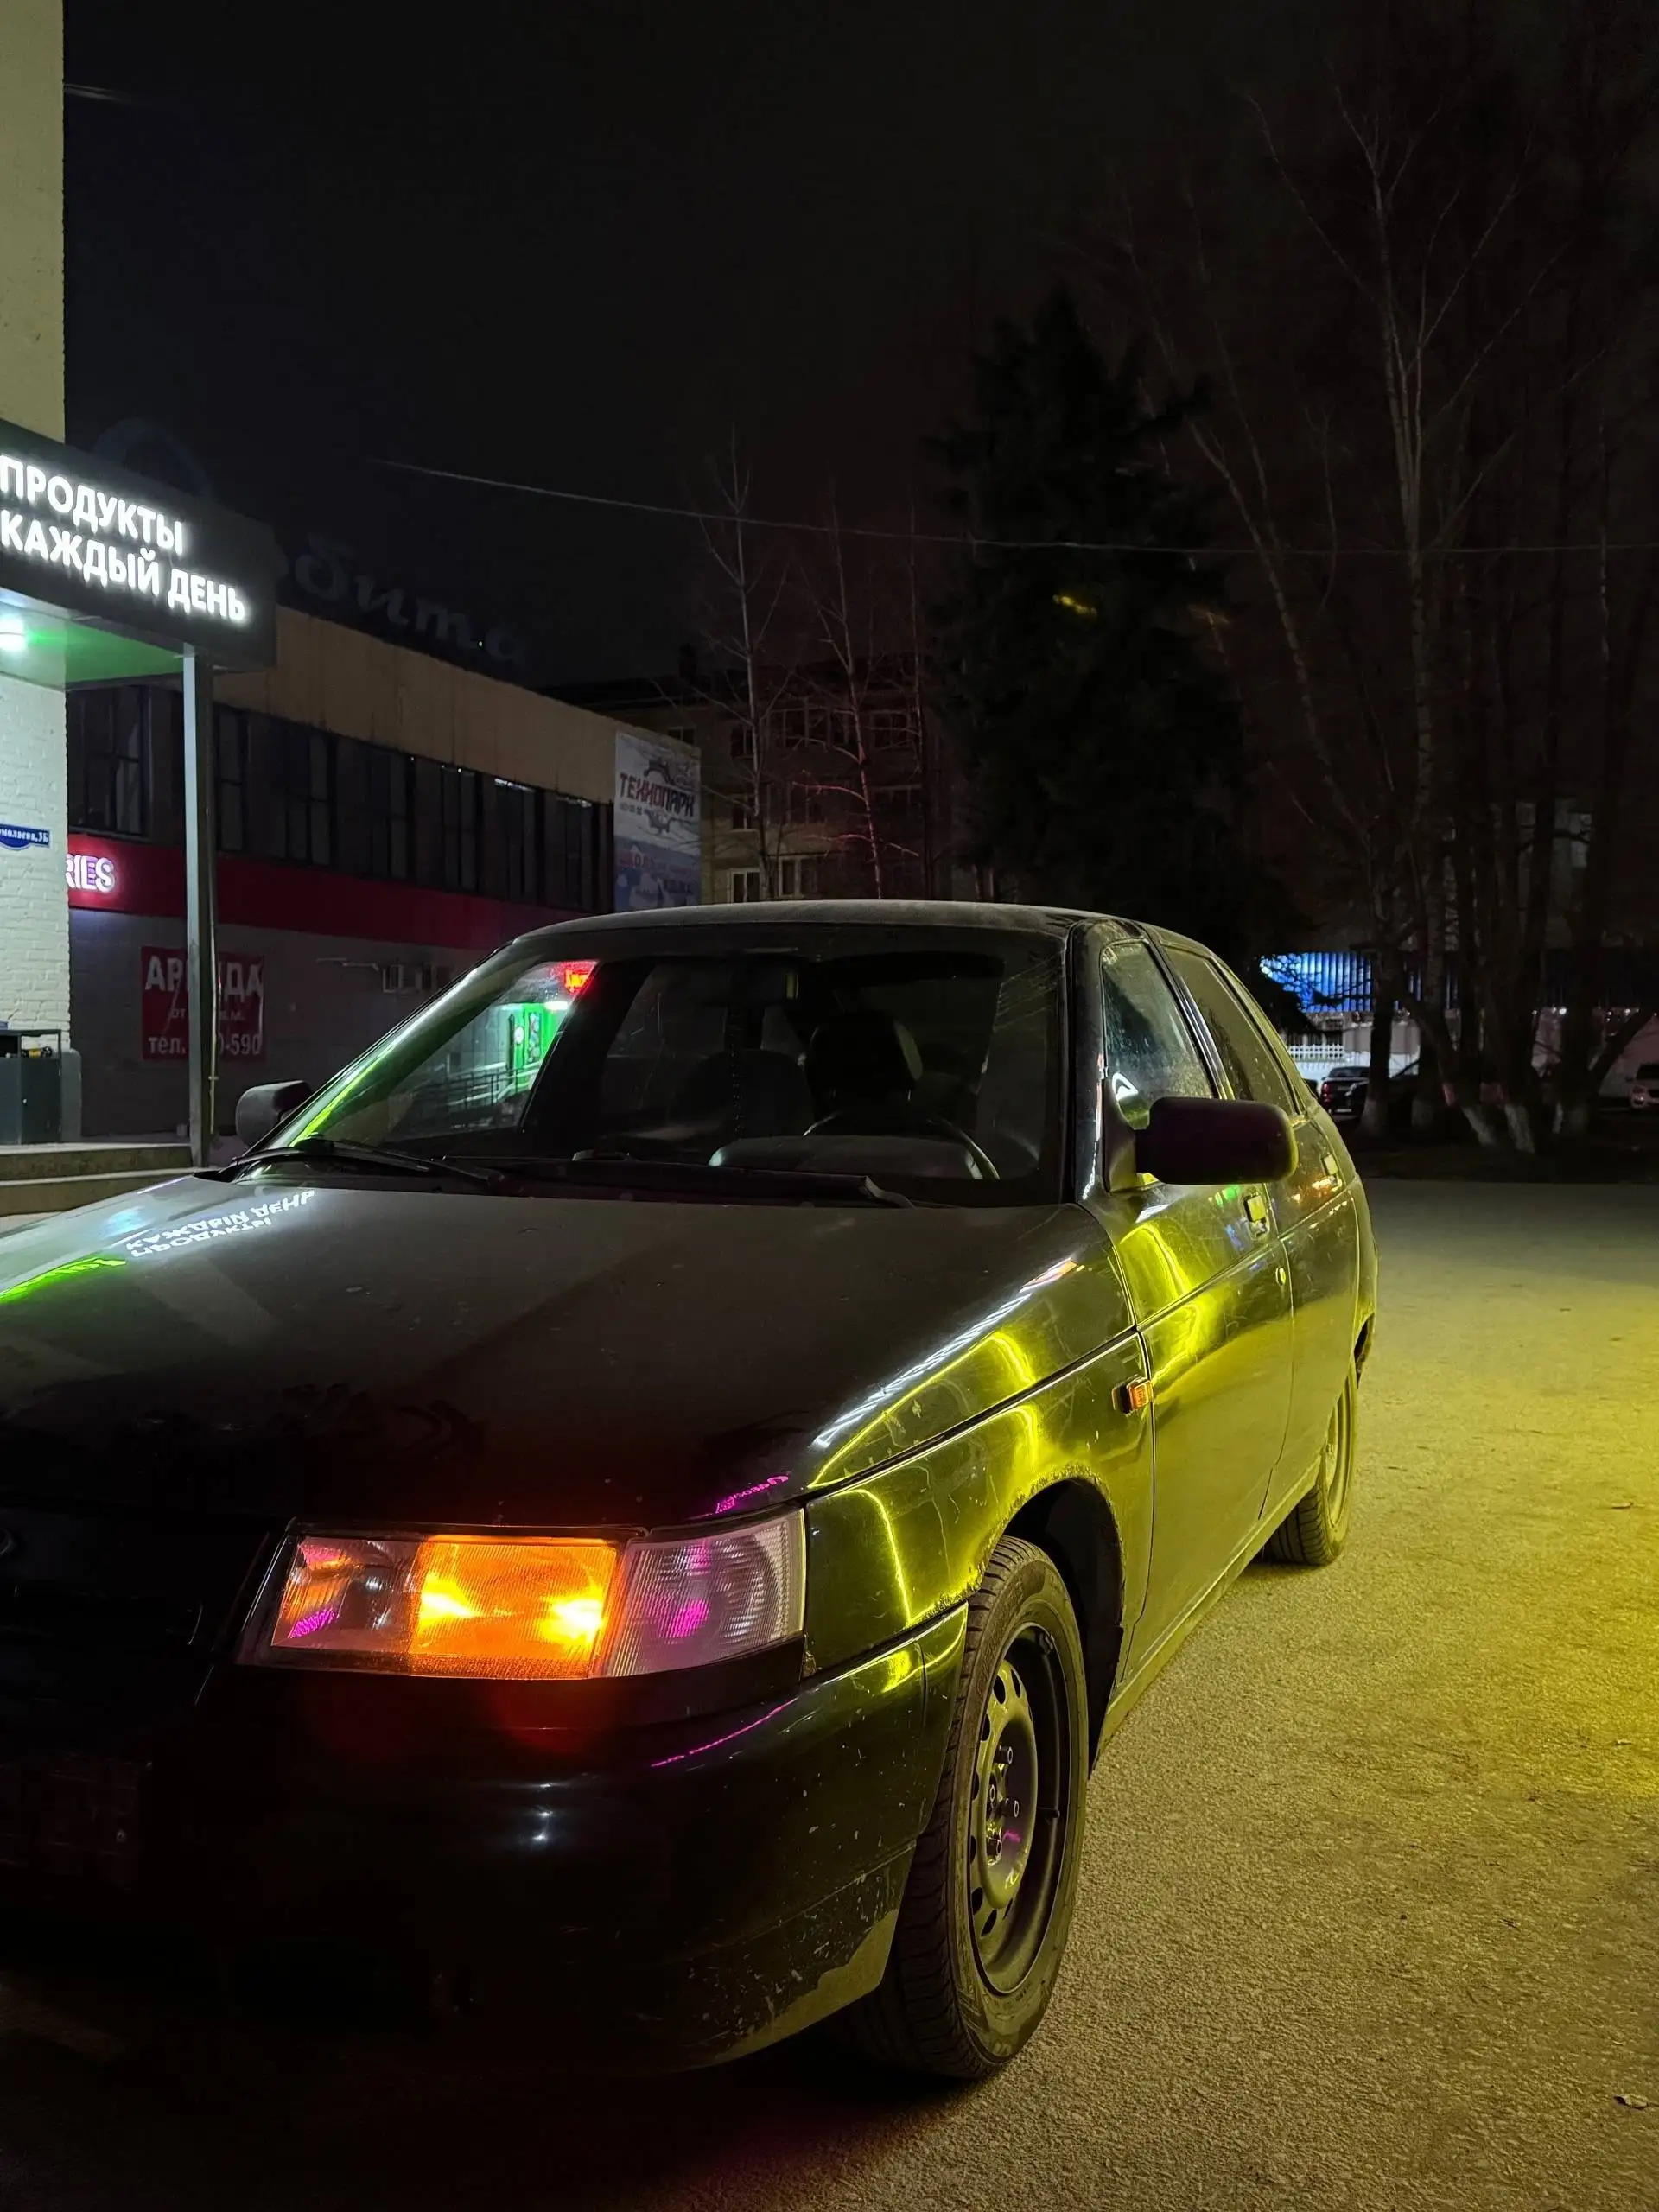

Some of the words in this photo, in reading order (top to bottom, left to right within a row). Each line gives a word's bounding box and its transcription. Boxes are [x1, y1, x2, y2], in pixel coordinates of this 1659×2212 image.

[0, 455, 183, 556] ПРОДУКТЫ
[2, 510, 160, 596] КАЖДЫЙ
[168, 569, 245, 620] ДЕНЬ
[144, 954, 264, 1003] АРДА
